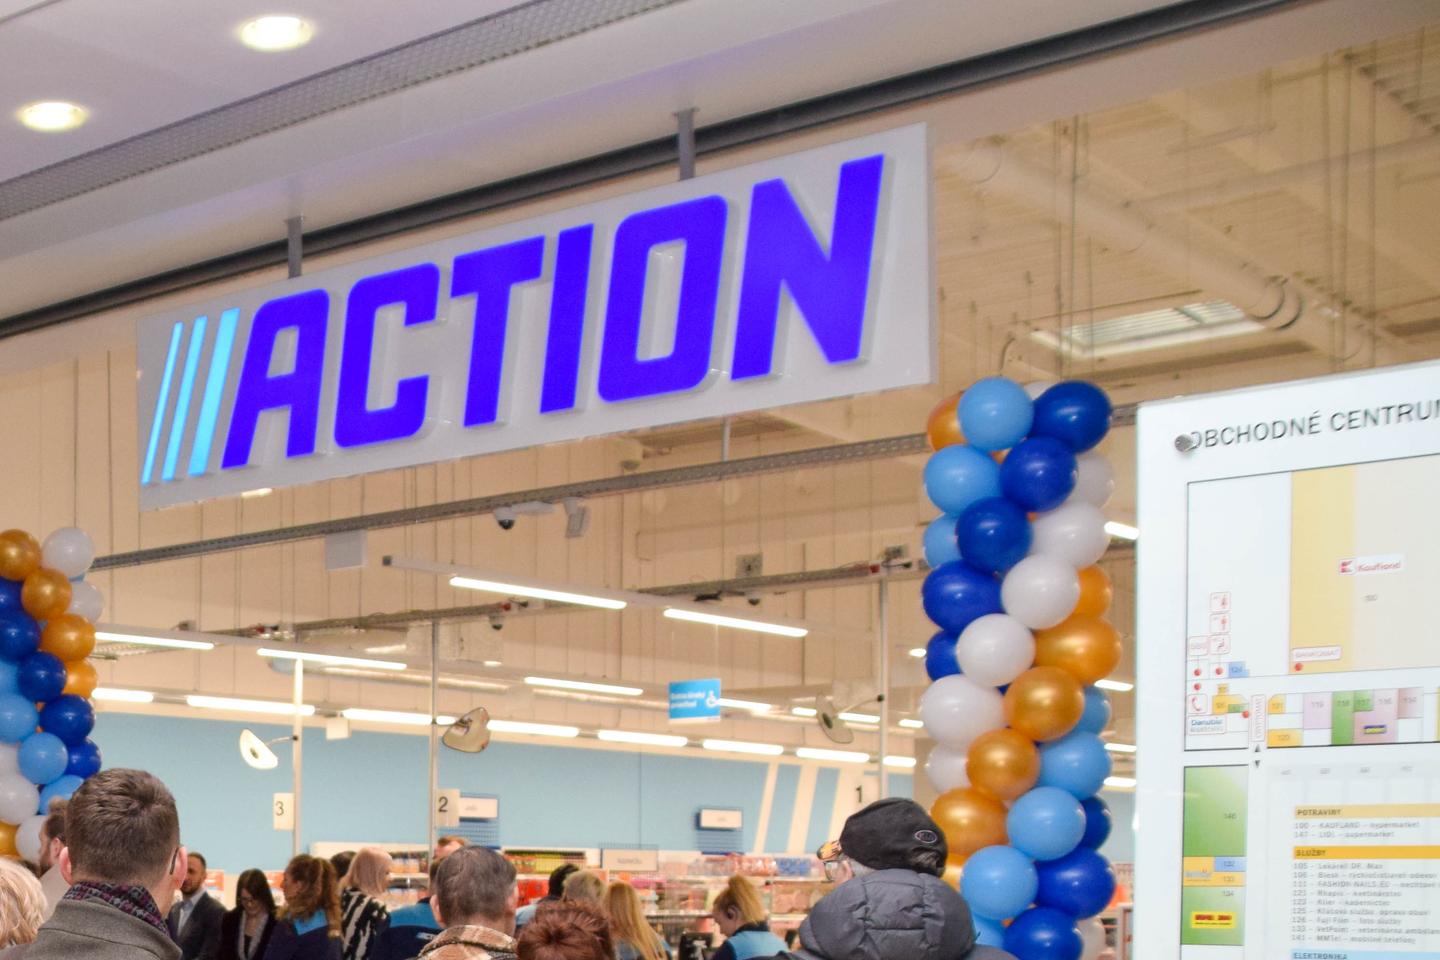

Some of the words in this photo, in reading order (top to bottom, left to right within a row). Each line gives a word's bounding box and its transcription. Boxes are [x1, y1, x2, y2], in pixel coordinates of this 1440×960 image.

[221, 154, 885, 470] ACTION
[1329, 399, 1440, 432] CENTRU
[856, 785, 862, 803] 1
[275, 800, 286, 817] 3
[438, 796, 449, 813] 2
[1293, 952, 1347, 960] ELEKTRONIKA
